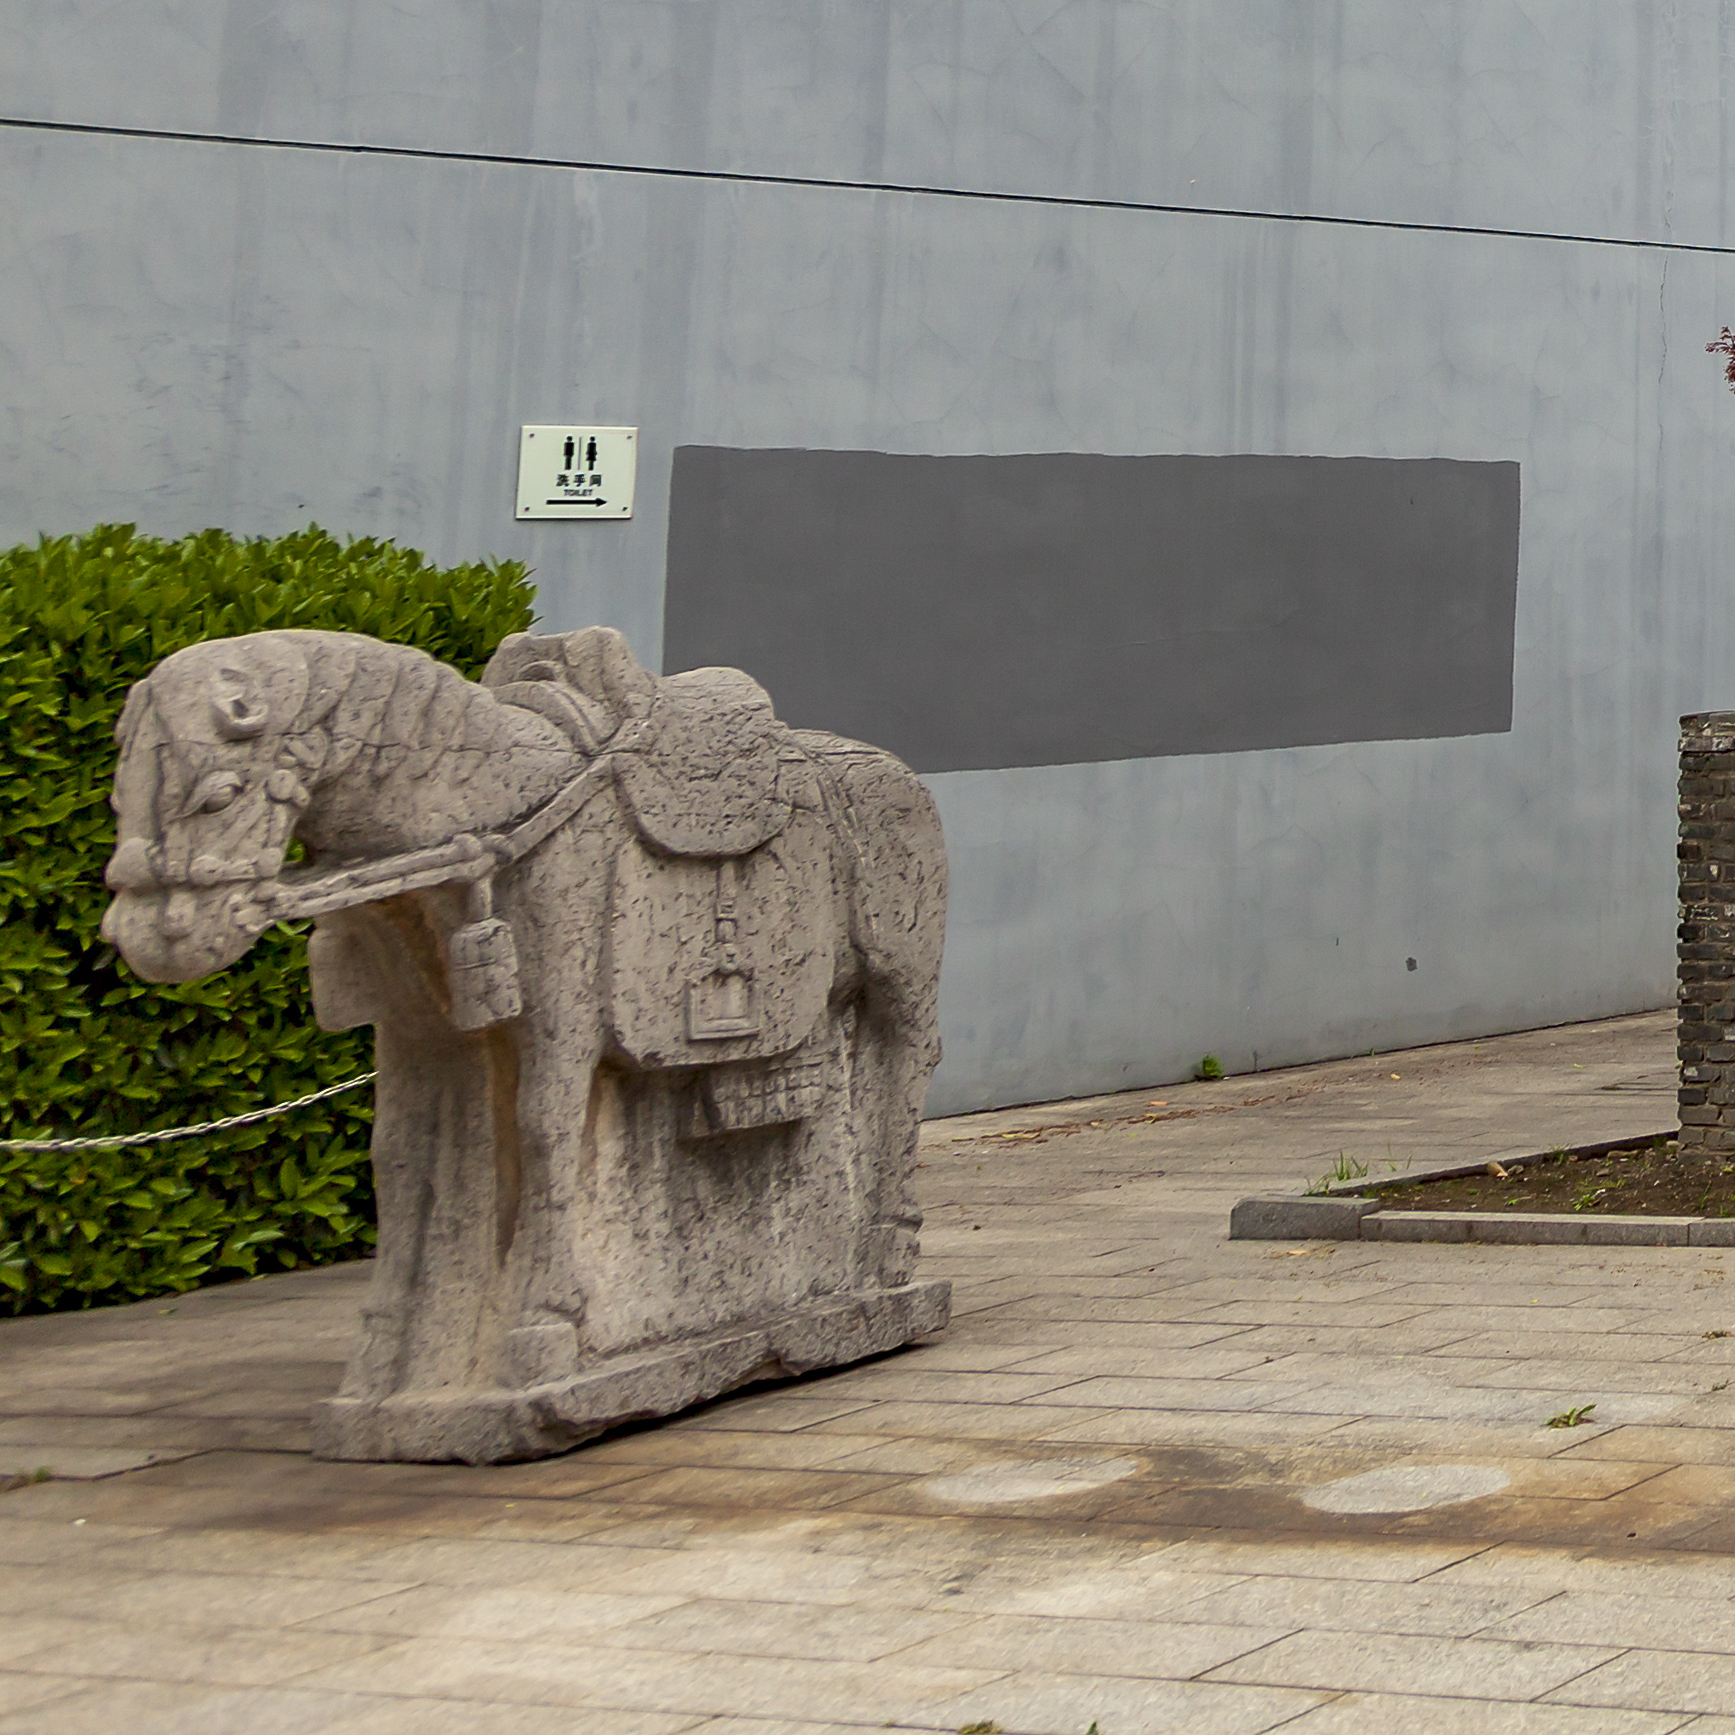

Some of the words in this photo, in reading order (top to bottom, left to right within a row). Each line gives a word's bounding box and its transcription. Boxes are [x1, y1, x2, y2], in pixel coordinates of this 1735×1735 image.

[556, 474, 602, 487] 洗手间
[563, 489, 593, 497] TOILET
